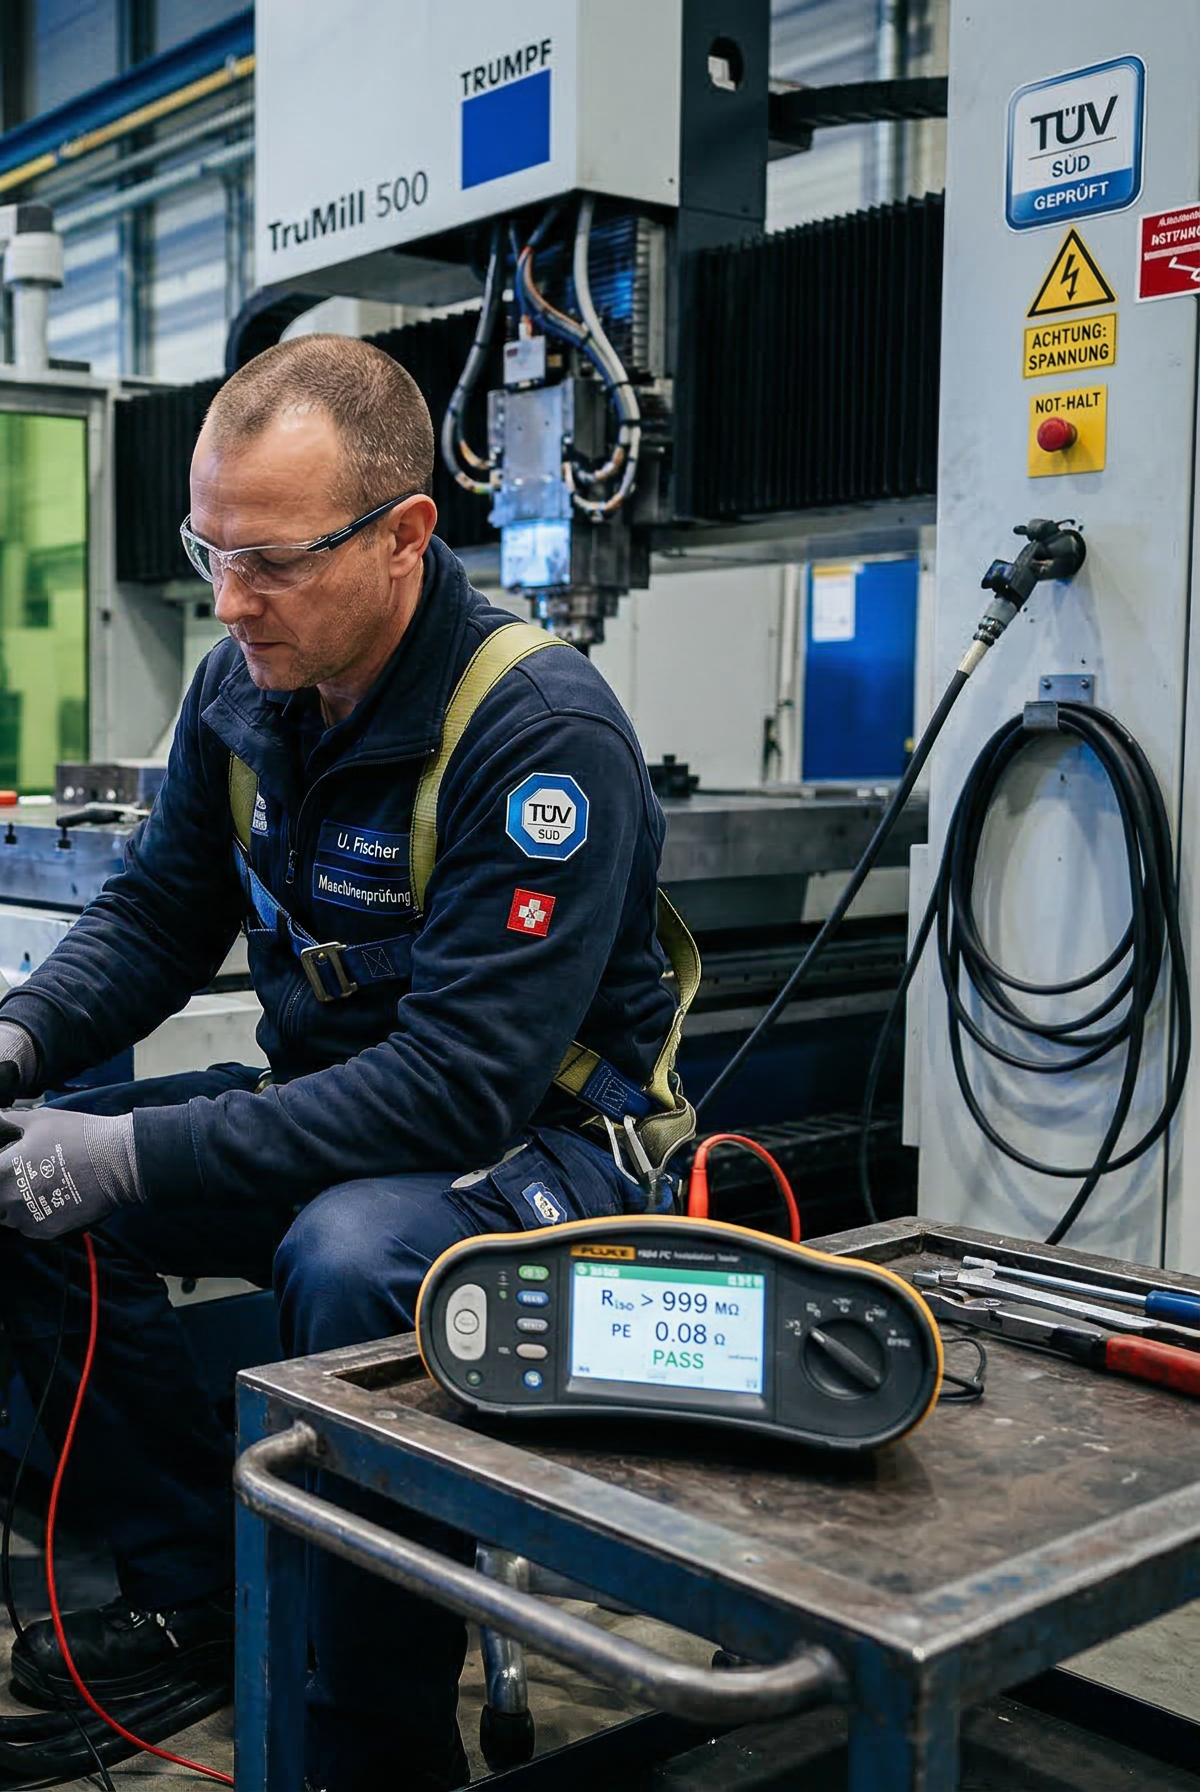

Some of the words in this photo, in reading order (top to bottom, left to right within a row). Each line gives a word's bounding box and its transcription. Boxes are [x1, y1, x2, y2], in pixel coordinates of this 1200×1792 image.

[460, 38, 551, 96] TRUMPF
[1030, 95, 1119, 151] TÜV
[1033, 181, 1110, 211] GEPRÜFT
[268, 190, 364, 255] TruMill
[376, 171, 428, 218] 500
[1031, 323, 1107, 350] ACHTUNG:
[1028, 343, 1109, 371] SPANNUNG
[1035, 392, 1101, 414] NOT-HALT
[528, 803, 572, 824] TÜV
[337, 832, 350, 851] U.
[353, 836, 400, 860] Fischer
[662, 1291, 708, 1314] 999
[611, 1323, 632, 1338] PE
[655, 1321, 707, 1345] 0.08
[653, 1350, 704, 1370] PASS
